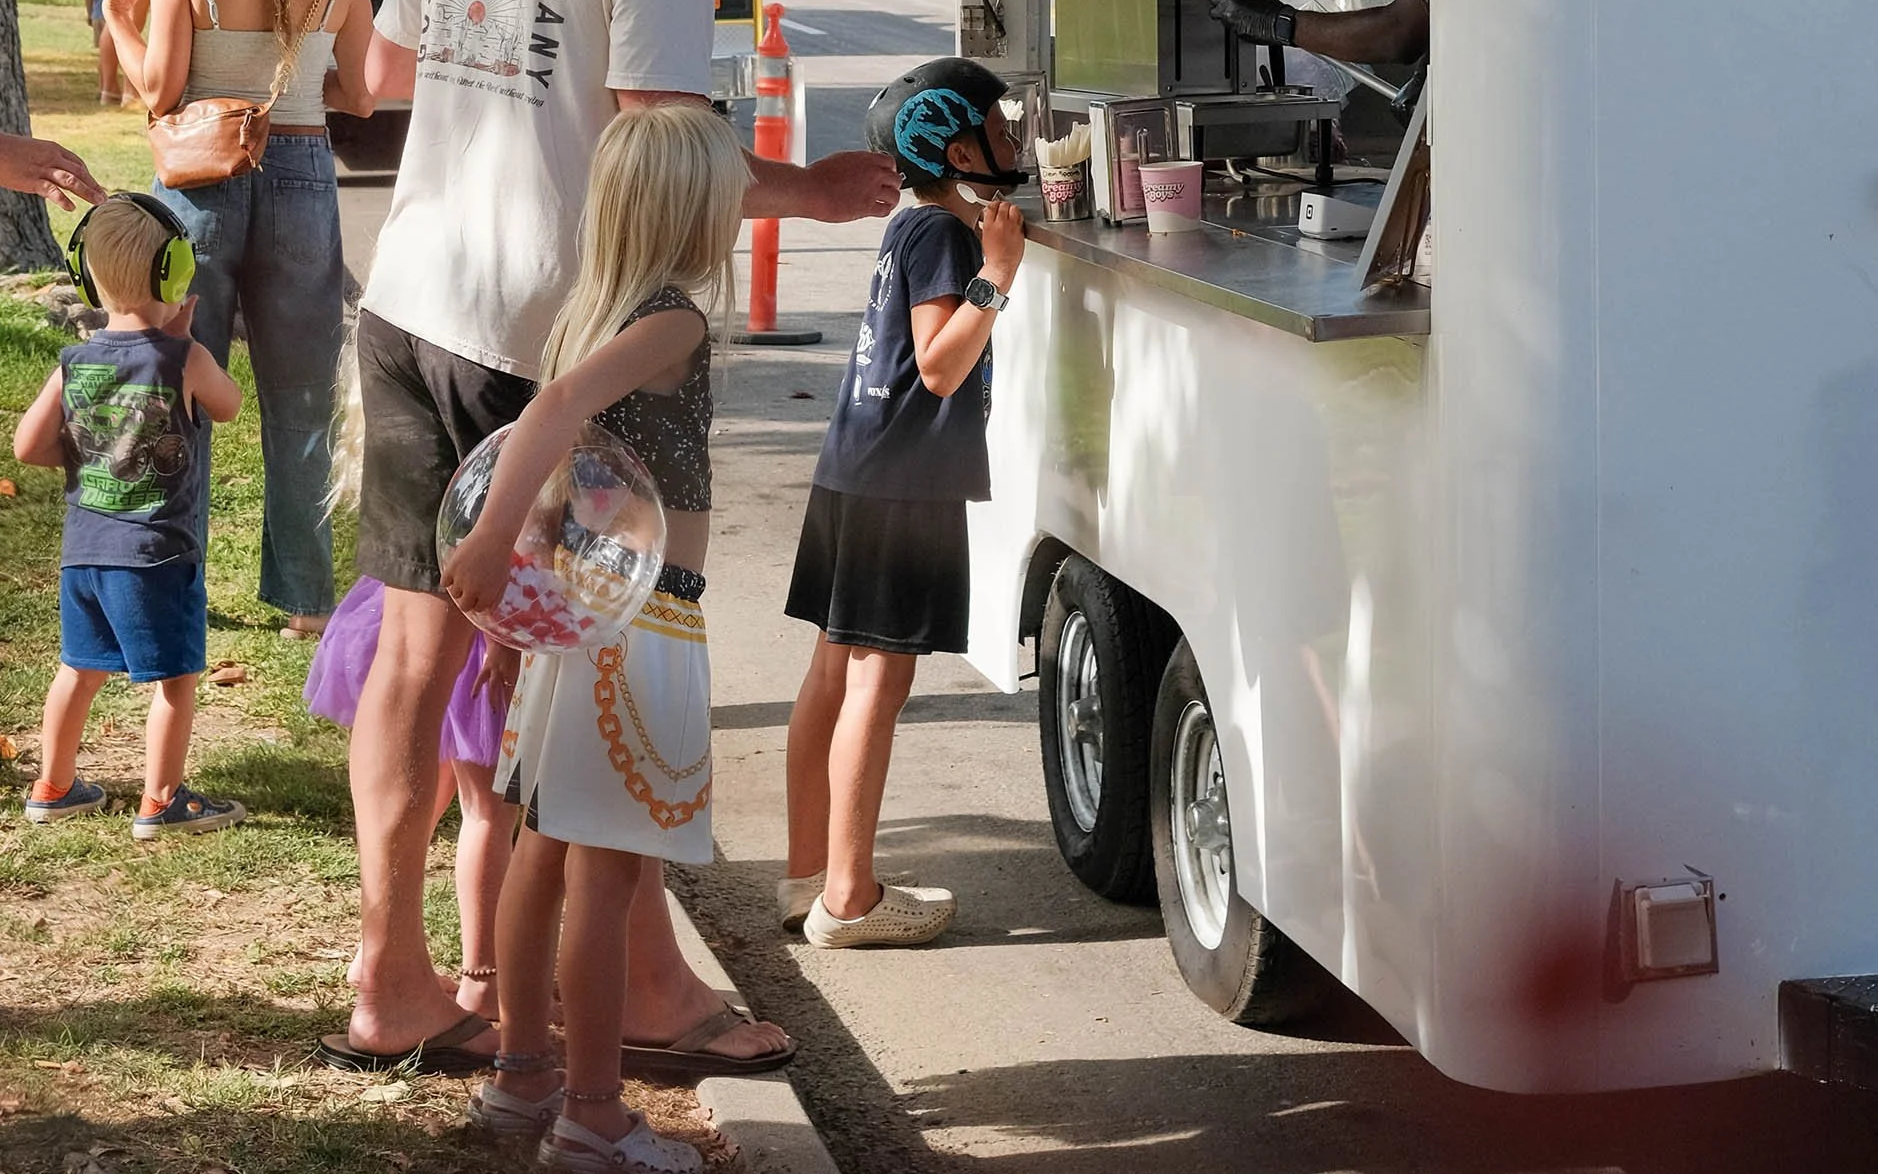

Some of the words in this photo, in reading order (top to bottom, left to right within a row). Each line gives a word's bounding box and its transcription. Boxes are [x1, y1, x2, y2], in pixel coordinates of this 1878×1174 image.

[1041, 181, 1084, 195] Creamy
[1143, 182, 1185, 195] Creamy
[1048, 190, 1075, 204] Boys
[1149, 190, 1175, 203] Boys
